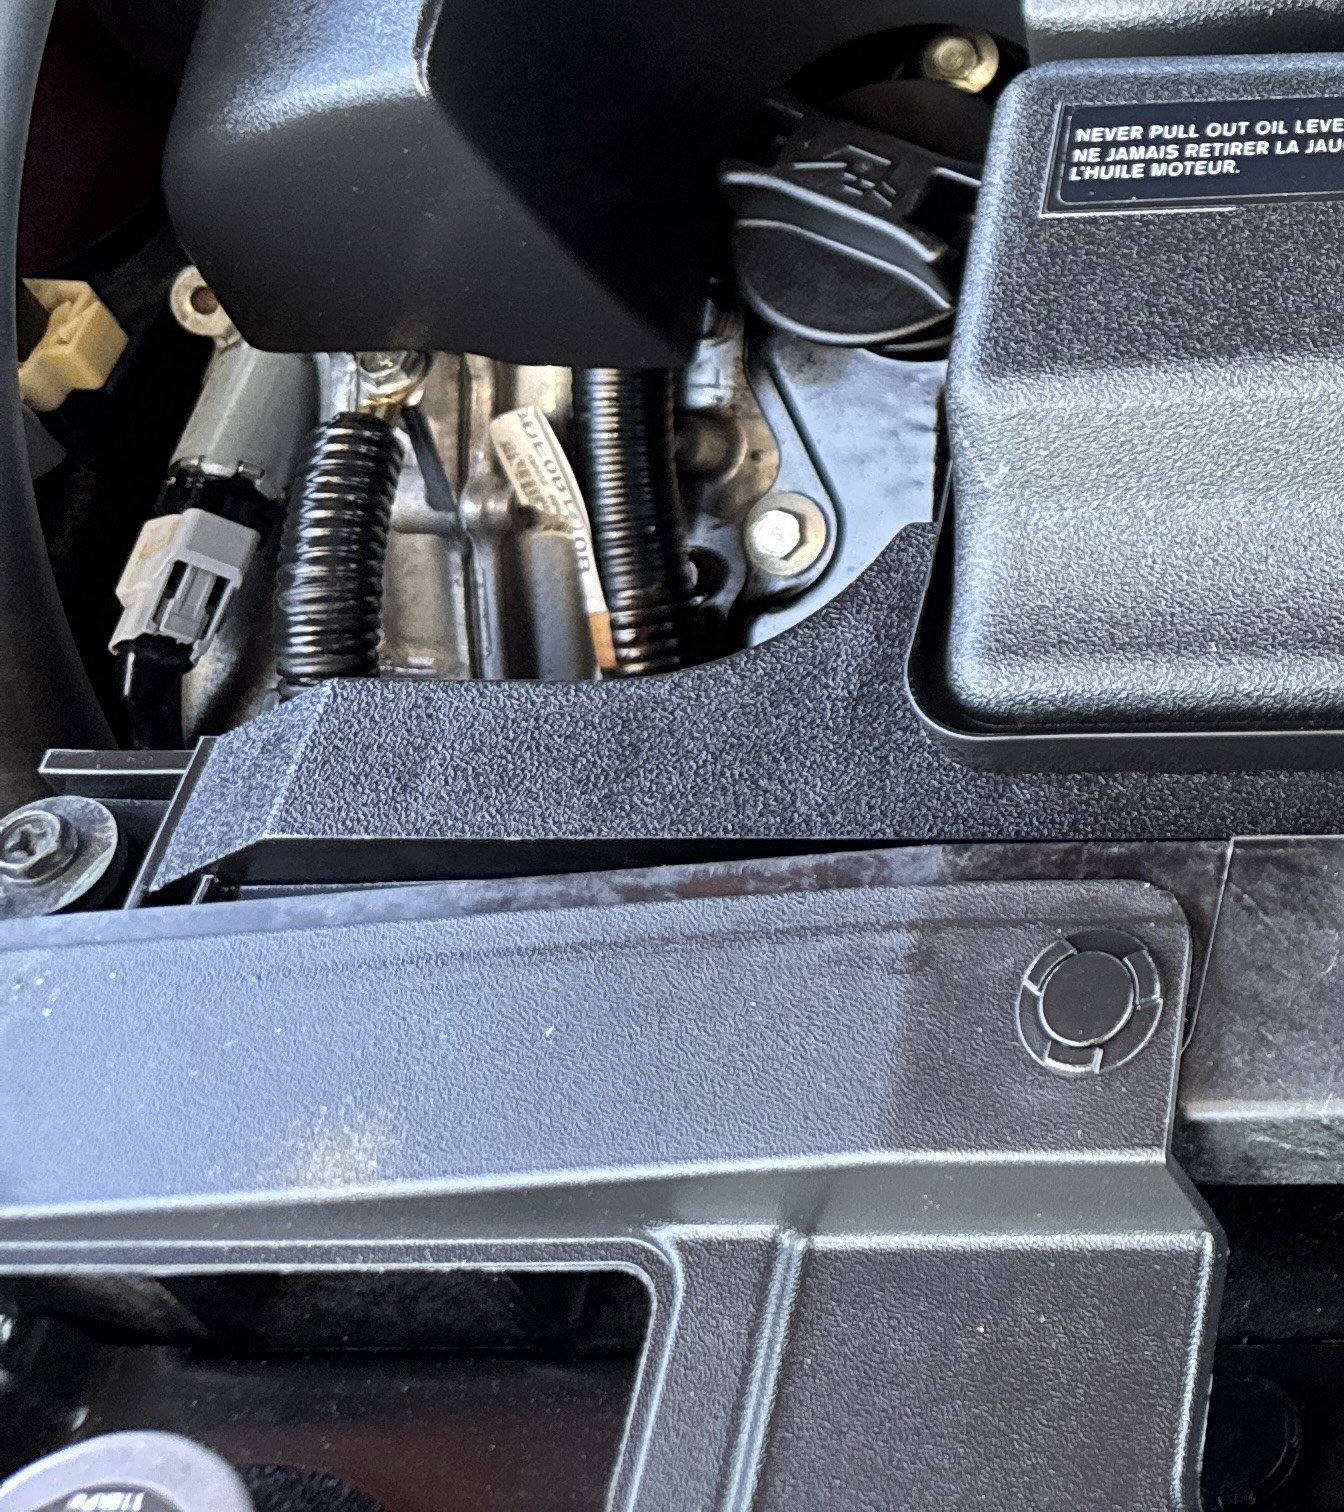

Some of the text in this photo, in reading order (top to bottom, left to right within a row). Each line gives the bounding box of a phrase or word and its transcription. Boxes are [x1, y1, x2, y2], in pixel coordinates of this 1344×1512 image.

[1075, 125, 1143, 142] NEVER
[1150, 124, 1199, 140] PULL
[1206, 121, 1250, 138] OUT
[1255, 119, 1288, 136] OIL
[1072, 148, 1101, 163] NE
[1105, 143, 1179, 161] JAMAIS
[1185, 140, 1268, 158] RETIRER
[1275, 139, 1299, 155] LA
[1069, 159, 1240, 181] L'HUILE MOTEUR.
